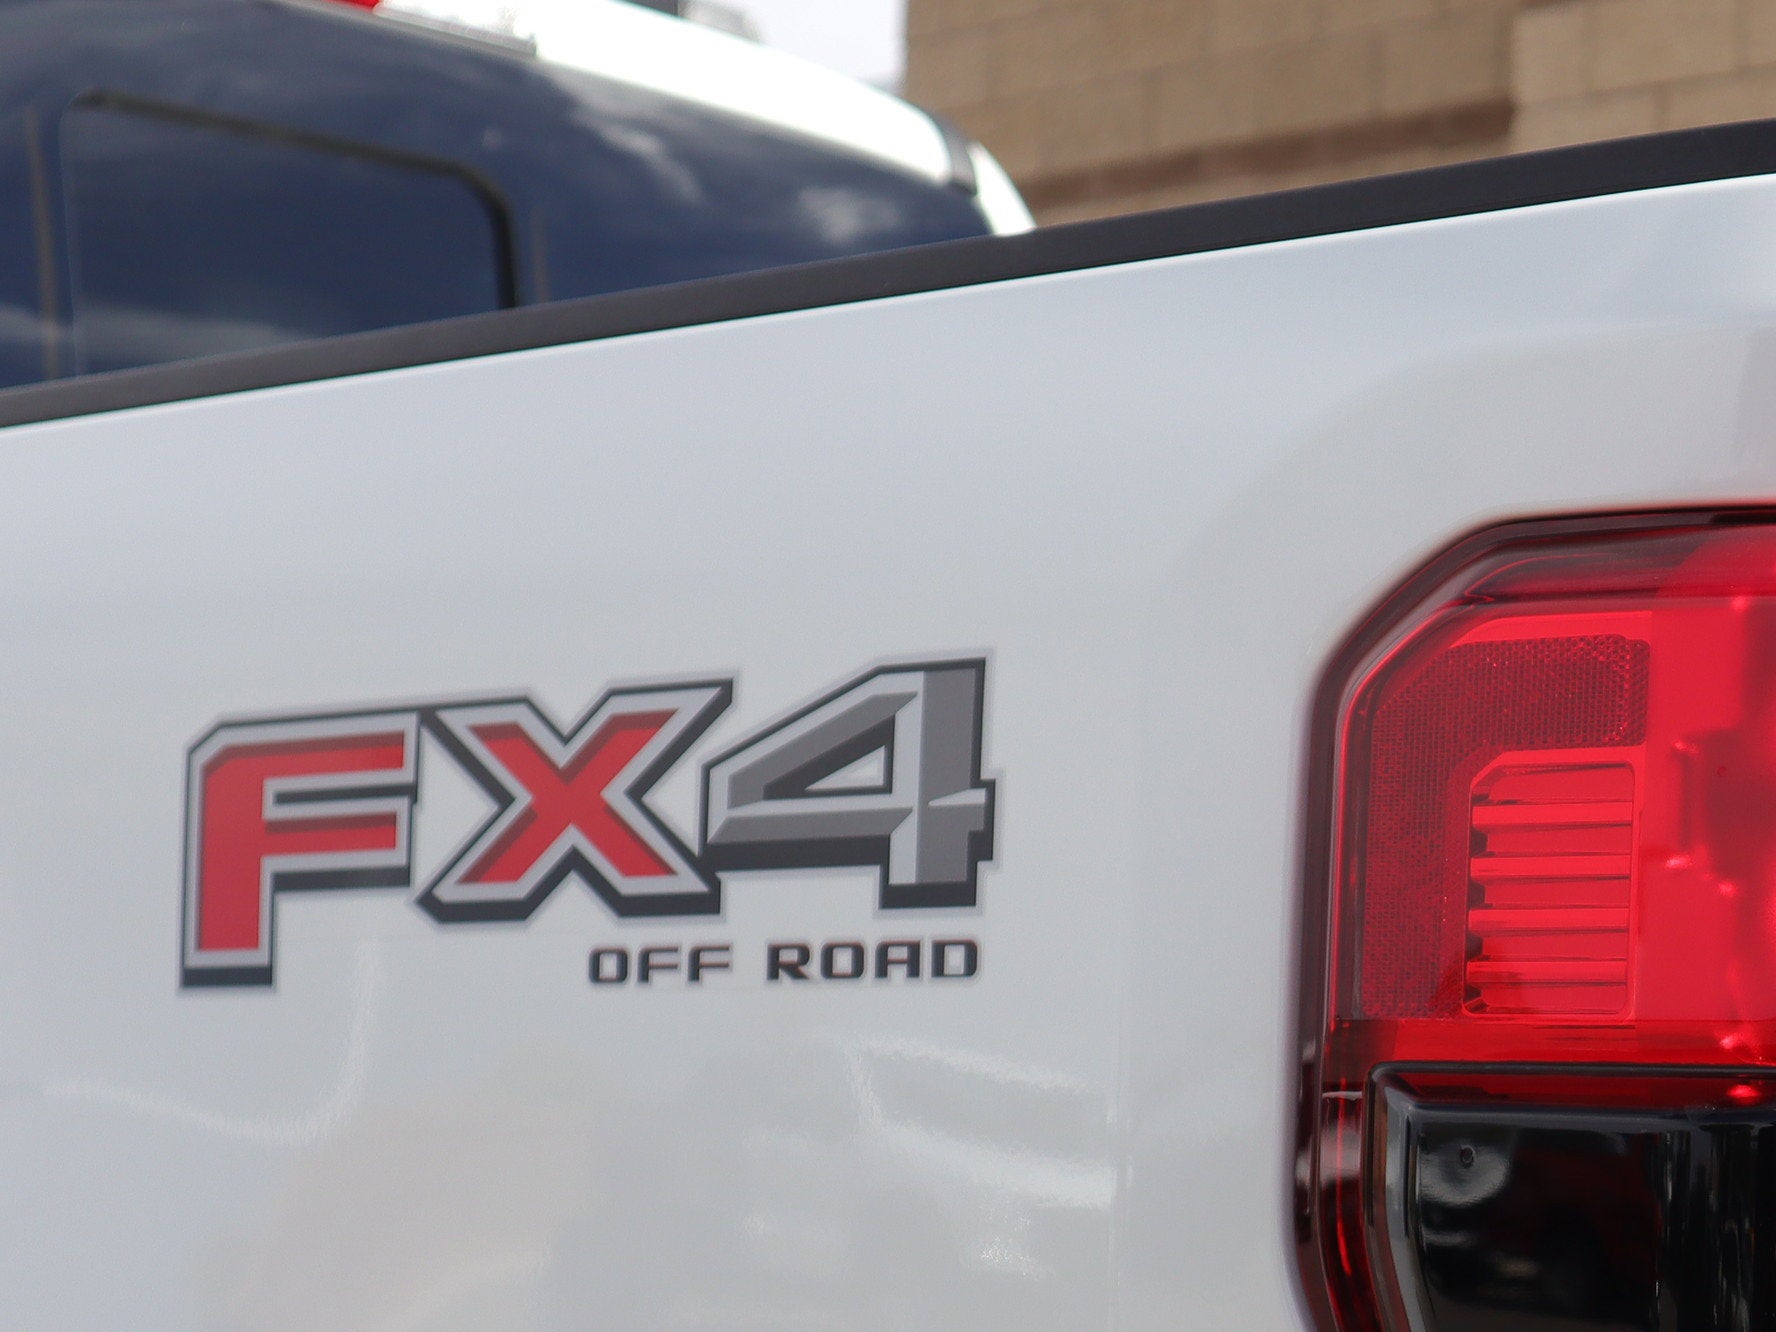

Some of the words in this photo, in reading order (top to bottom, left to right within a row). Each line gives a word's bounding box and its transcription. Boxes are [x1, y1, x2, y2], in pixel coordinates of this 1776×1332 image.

[182, 656, 996, 986] FX4
[588, 943, 731, 984] OFF
[766, 937, 979, 981] ROAD
